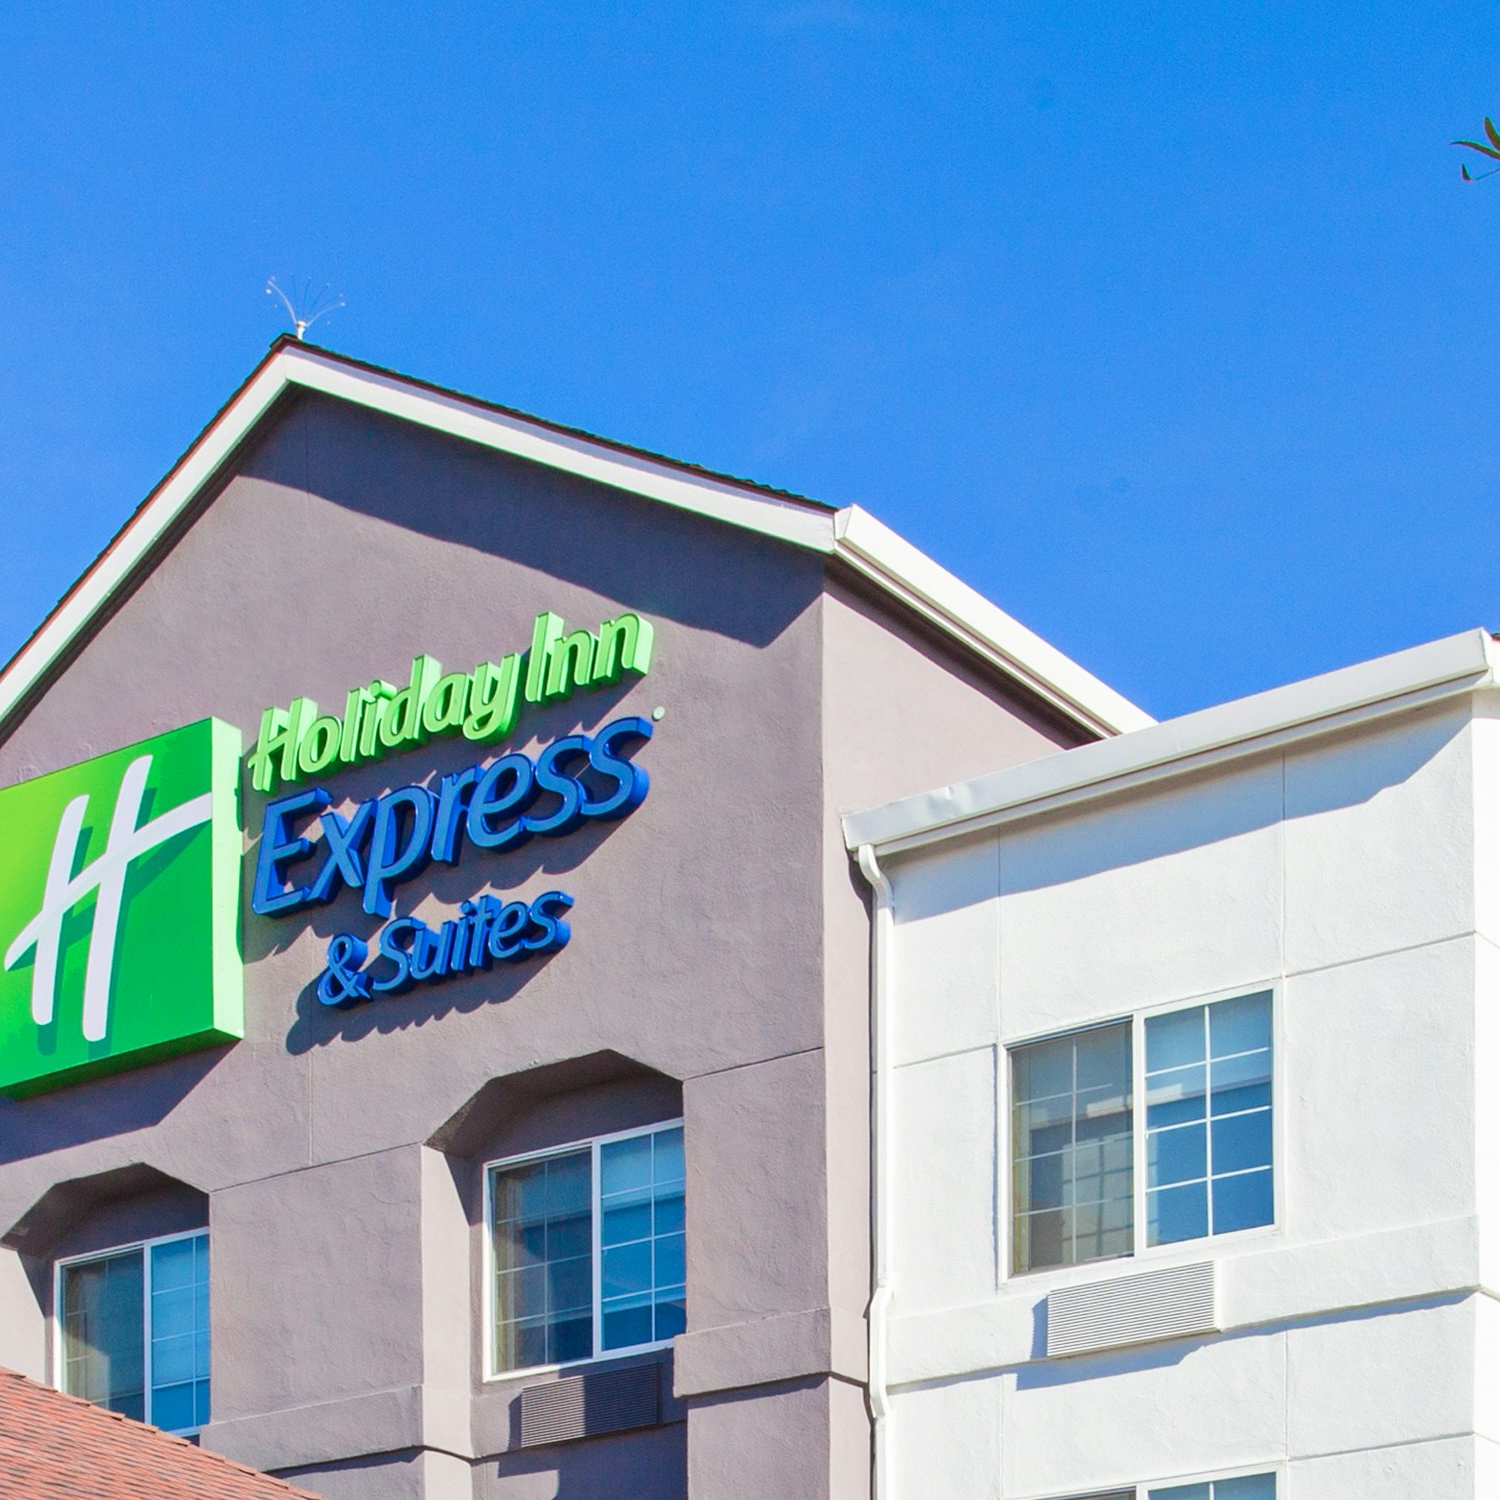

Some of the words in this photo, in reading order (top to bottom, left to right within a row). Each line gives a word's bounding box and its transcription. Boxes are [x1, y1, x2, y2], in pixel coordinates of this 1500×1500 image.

[248, 654, 522, 791] Holiday
[525, 611, 654, 702] Inn
[252, 716, 655, 919] Express
[316, 933, 373, 1009] &
[370, 890, 575, 996] Suites
